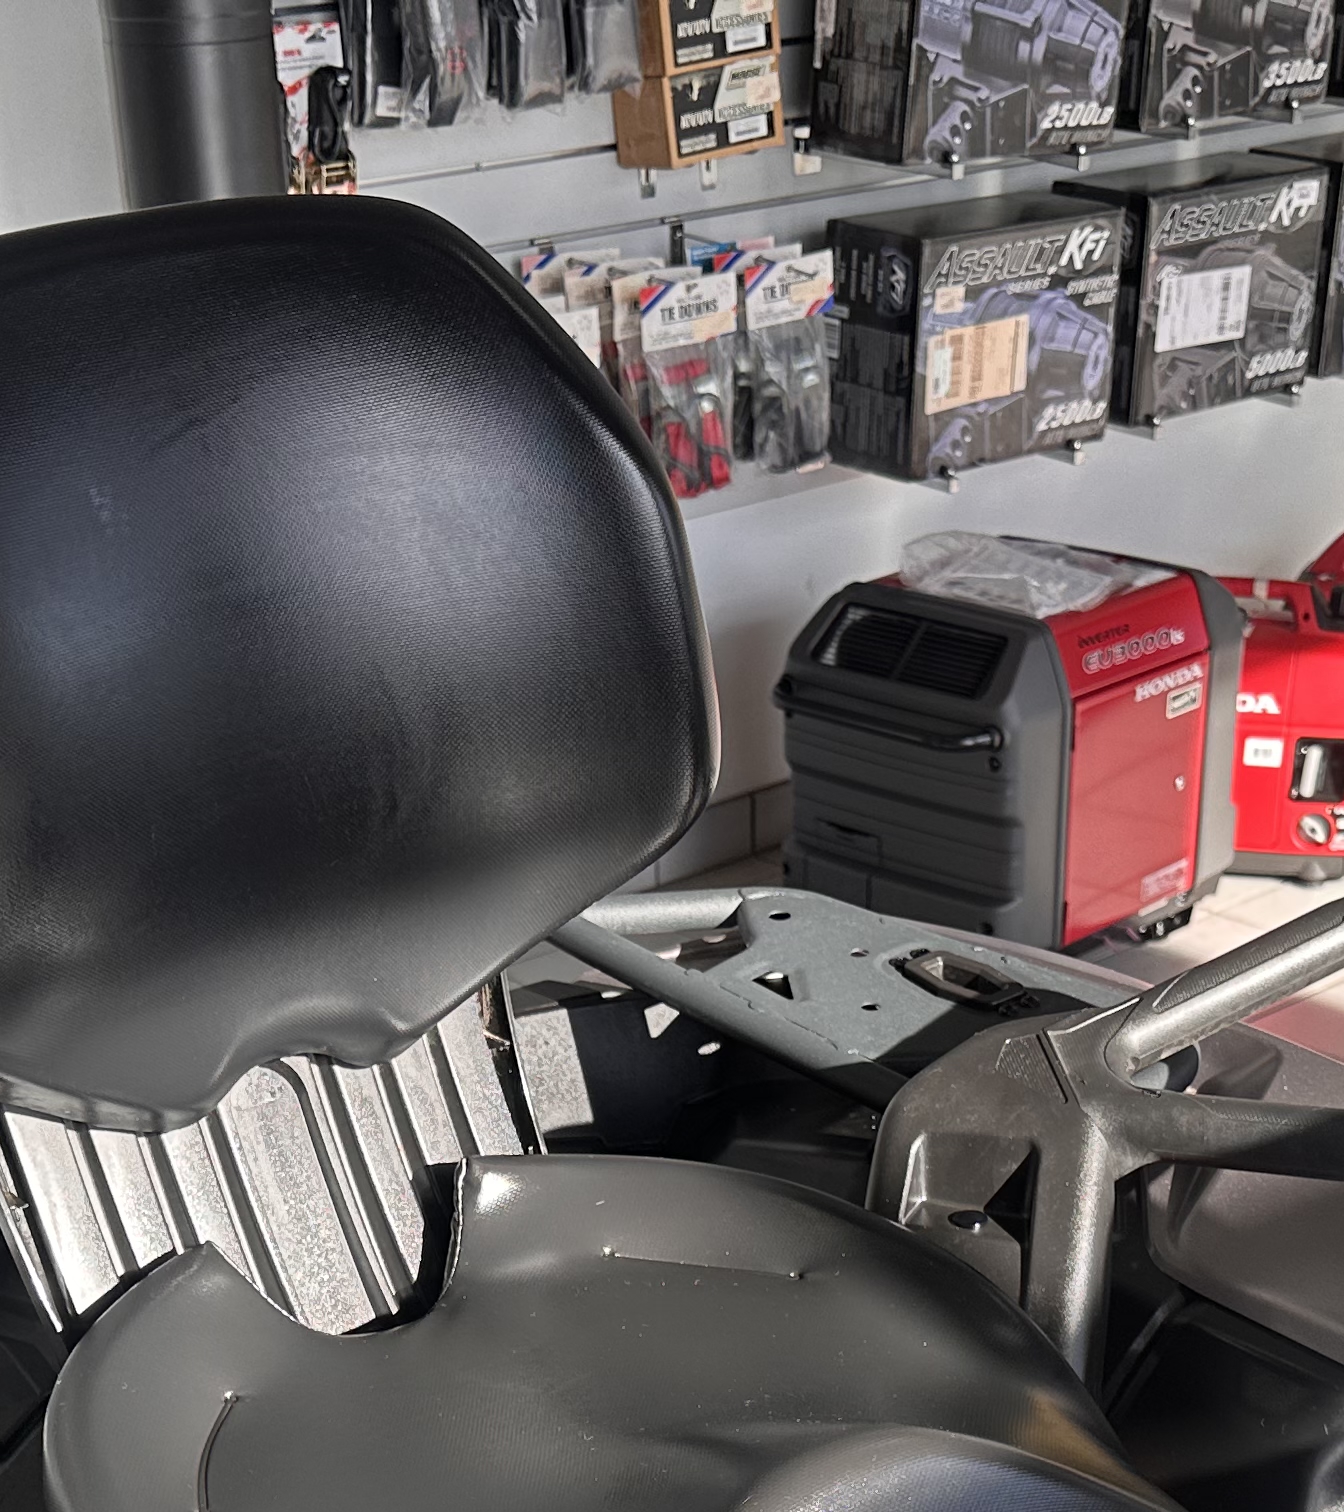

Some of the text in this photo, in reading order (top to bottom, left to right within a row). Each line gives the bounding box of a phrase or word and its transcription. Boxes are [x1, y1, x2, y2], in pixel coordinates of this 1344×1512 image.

[1149, 191, 1274, 250] ASSAULT
[923, 236, 1066, 293] ASSAULT
[1134, 662, 1205, 703] HONDA
